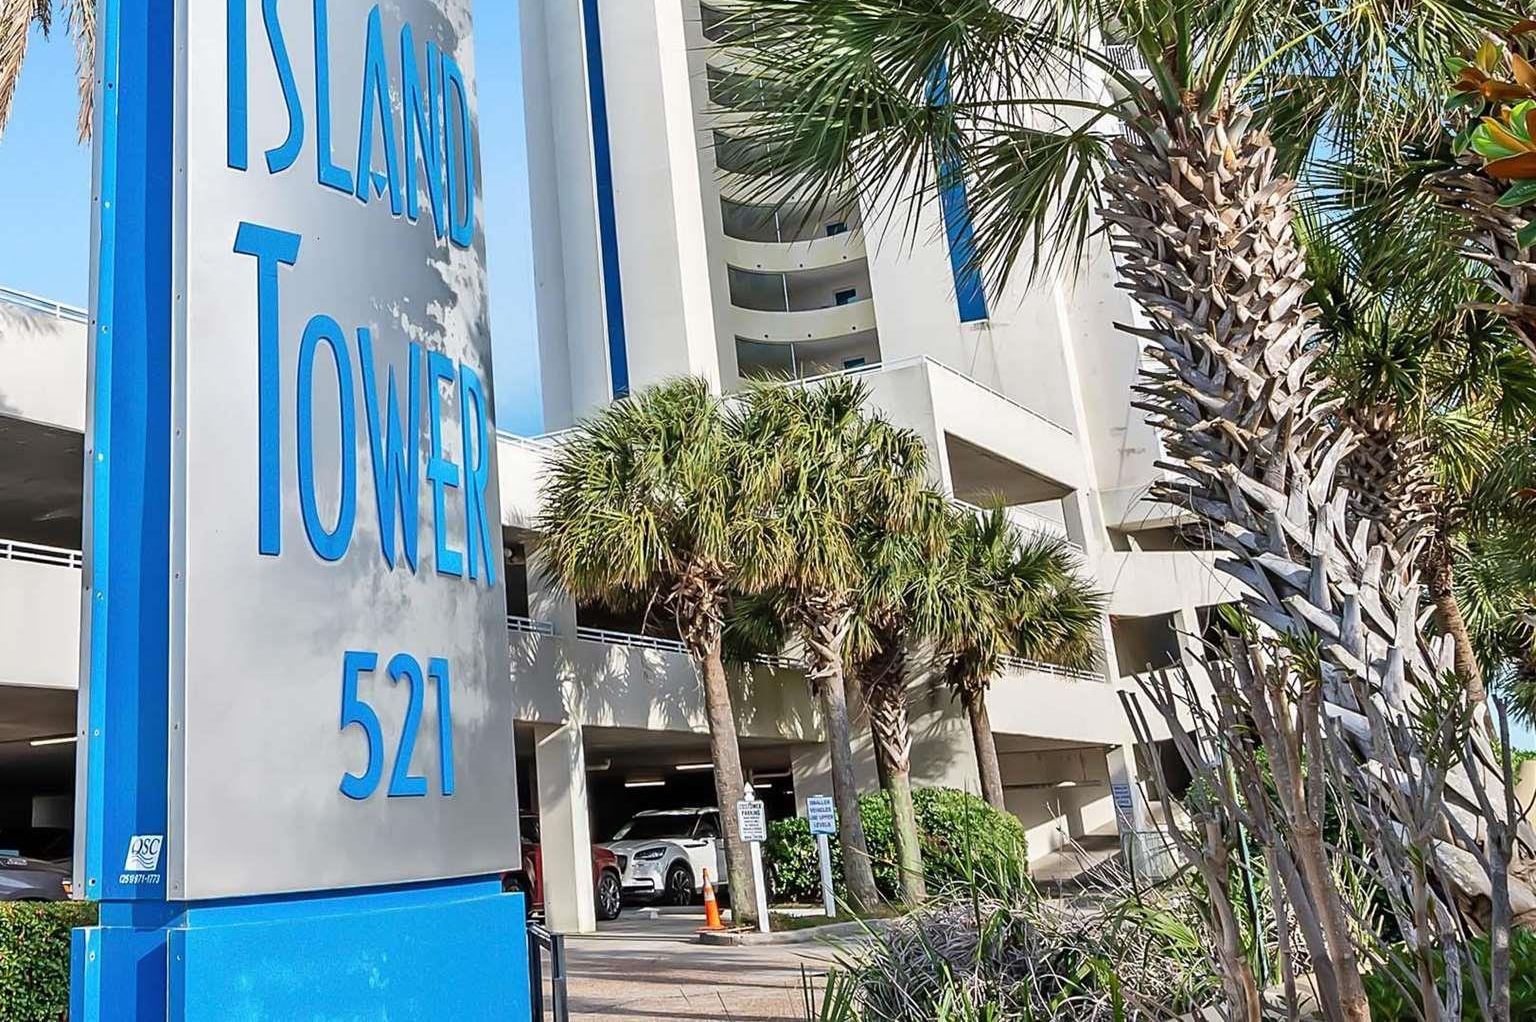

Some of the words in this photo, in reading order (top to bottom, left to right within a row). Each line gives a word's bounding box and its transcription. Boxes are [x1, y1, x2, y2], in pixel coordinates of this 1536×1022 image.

[233, 221, 496, 587] TOWER
[339, 650, 455, 799] 521
[131, 838, 160, 855] QSC
